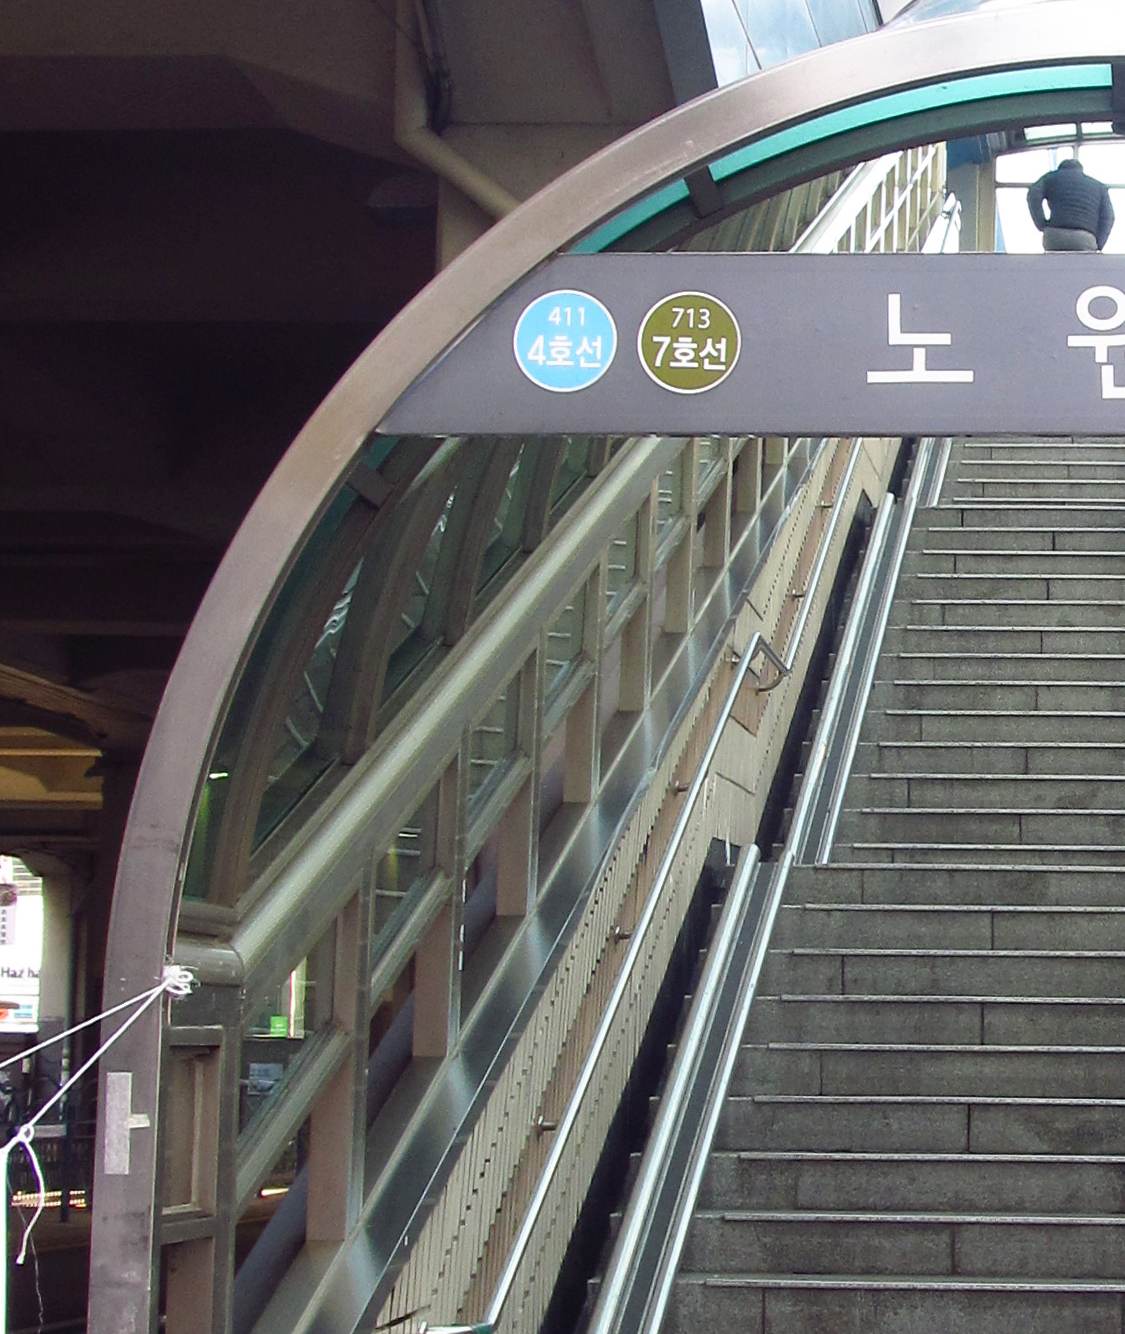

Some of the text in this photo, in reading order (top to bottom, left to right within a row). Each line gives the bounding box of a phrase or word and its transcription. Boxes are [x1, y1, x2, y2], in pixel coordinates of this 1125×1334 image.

[548, 306, 585, 326] 411
[671, 308, 711, 328] 713
[527, 335, 602, 368] 4호선
[652, 336, 727, 370] 7호선
